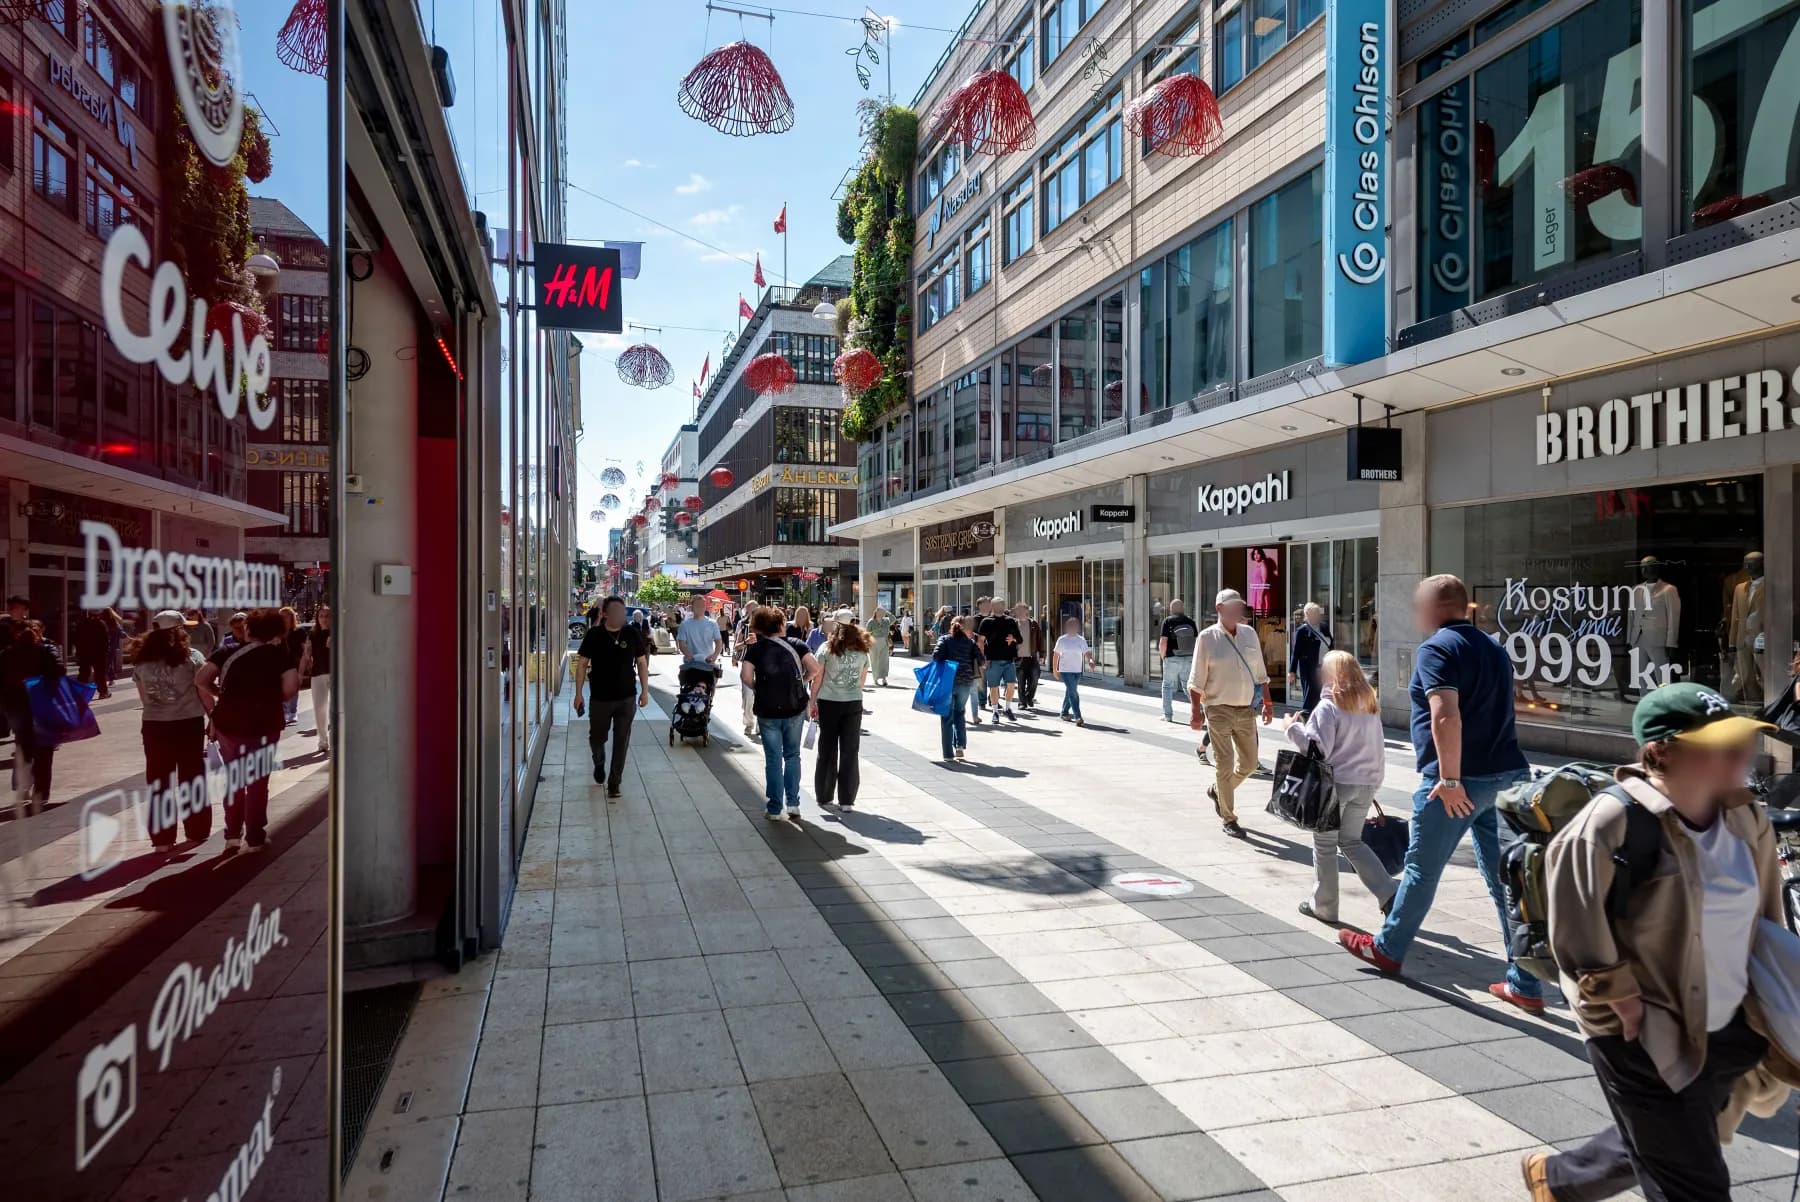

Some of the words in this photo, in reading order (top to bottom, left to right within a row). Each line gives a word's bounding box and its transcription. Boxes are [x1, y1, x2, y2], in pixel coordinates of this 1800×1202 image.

[1354, 22, 1379, 144] Ohlson
[944, 171, 982, 222] Nasdaq
[1354, 151, 1379, 230] Clas
[1542, 207, 1559, 257] Lager
[543, 263, 612, 310] H&M
[1198, 470, 1289, 516] Kappahl
[1360, 469, 1397, 480] BROTHERS
[1033, 509, 1081, 541] Kappahl
[1100, 508, 1128, 518] Kappahl
[80, 520, 282, 609] Dressmann
[1505, 577, 1653, 620] Kostym
[1489, 631, 1612, 686] 999
[1628, 647, 1683, 690] kr
